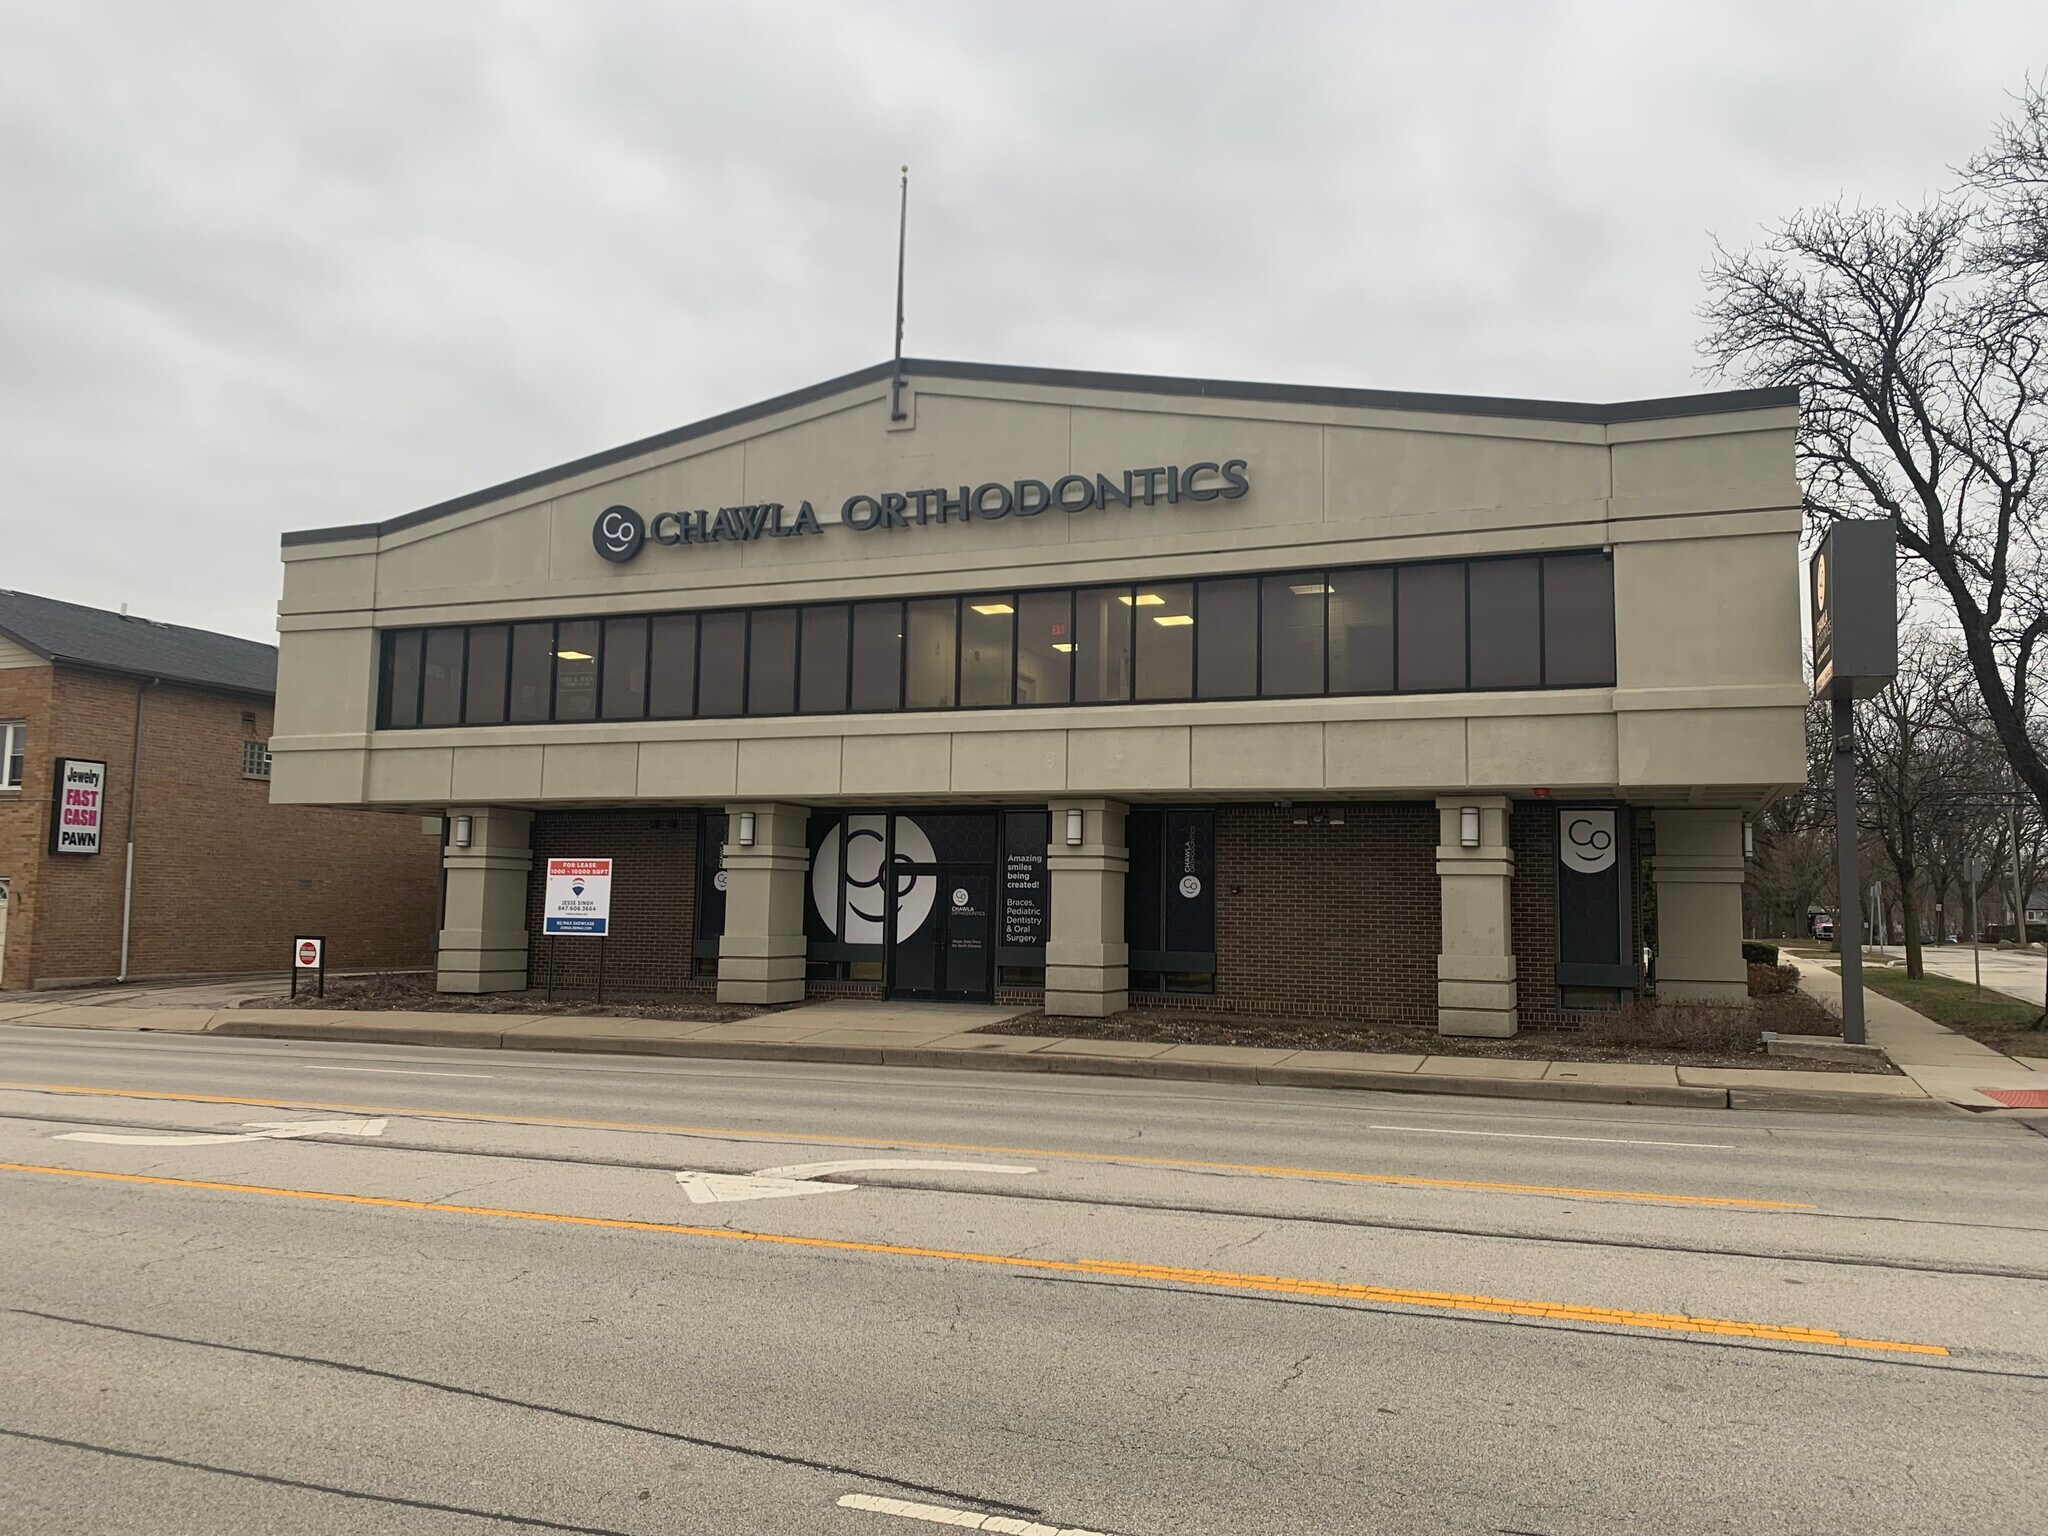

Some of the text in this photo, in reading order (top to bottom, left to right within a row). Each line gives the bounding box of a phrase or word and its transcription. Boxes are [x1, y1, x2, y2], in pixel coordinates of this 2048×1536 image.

[650, 459, 1250, 546] CHAWLA ORTHODONTICS
[67, 767, 100, 787] Jewelry
[66, 788, 99, 807] FAST
[64, 808, 97, 826] CASH
[61, 831, 97, 847] PAWN
[1007, 854, 1042, 863] Amazing
[1007, 863, 1032, 871] smiles
[1007, 872, 1030, 880] being
[1006, 898, 1035, 906] Braces,
[1006, 916, 1042, 926] Dentistry
[1006, 934, 1037, 943] Surgery
